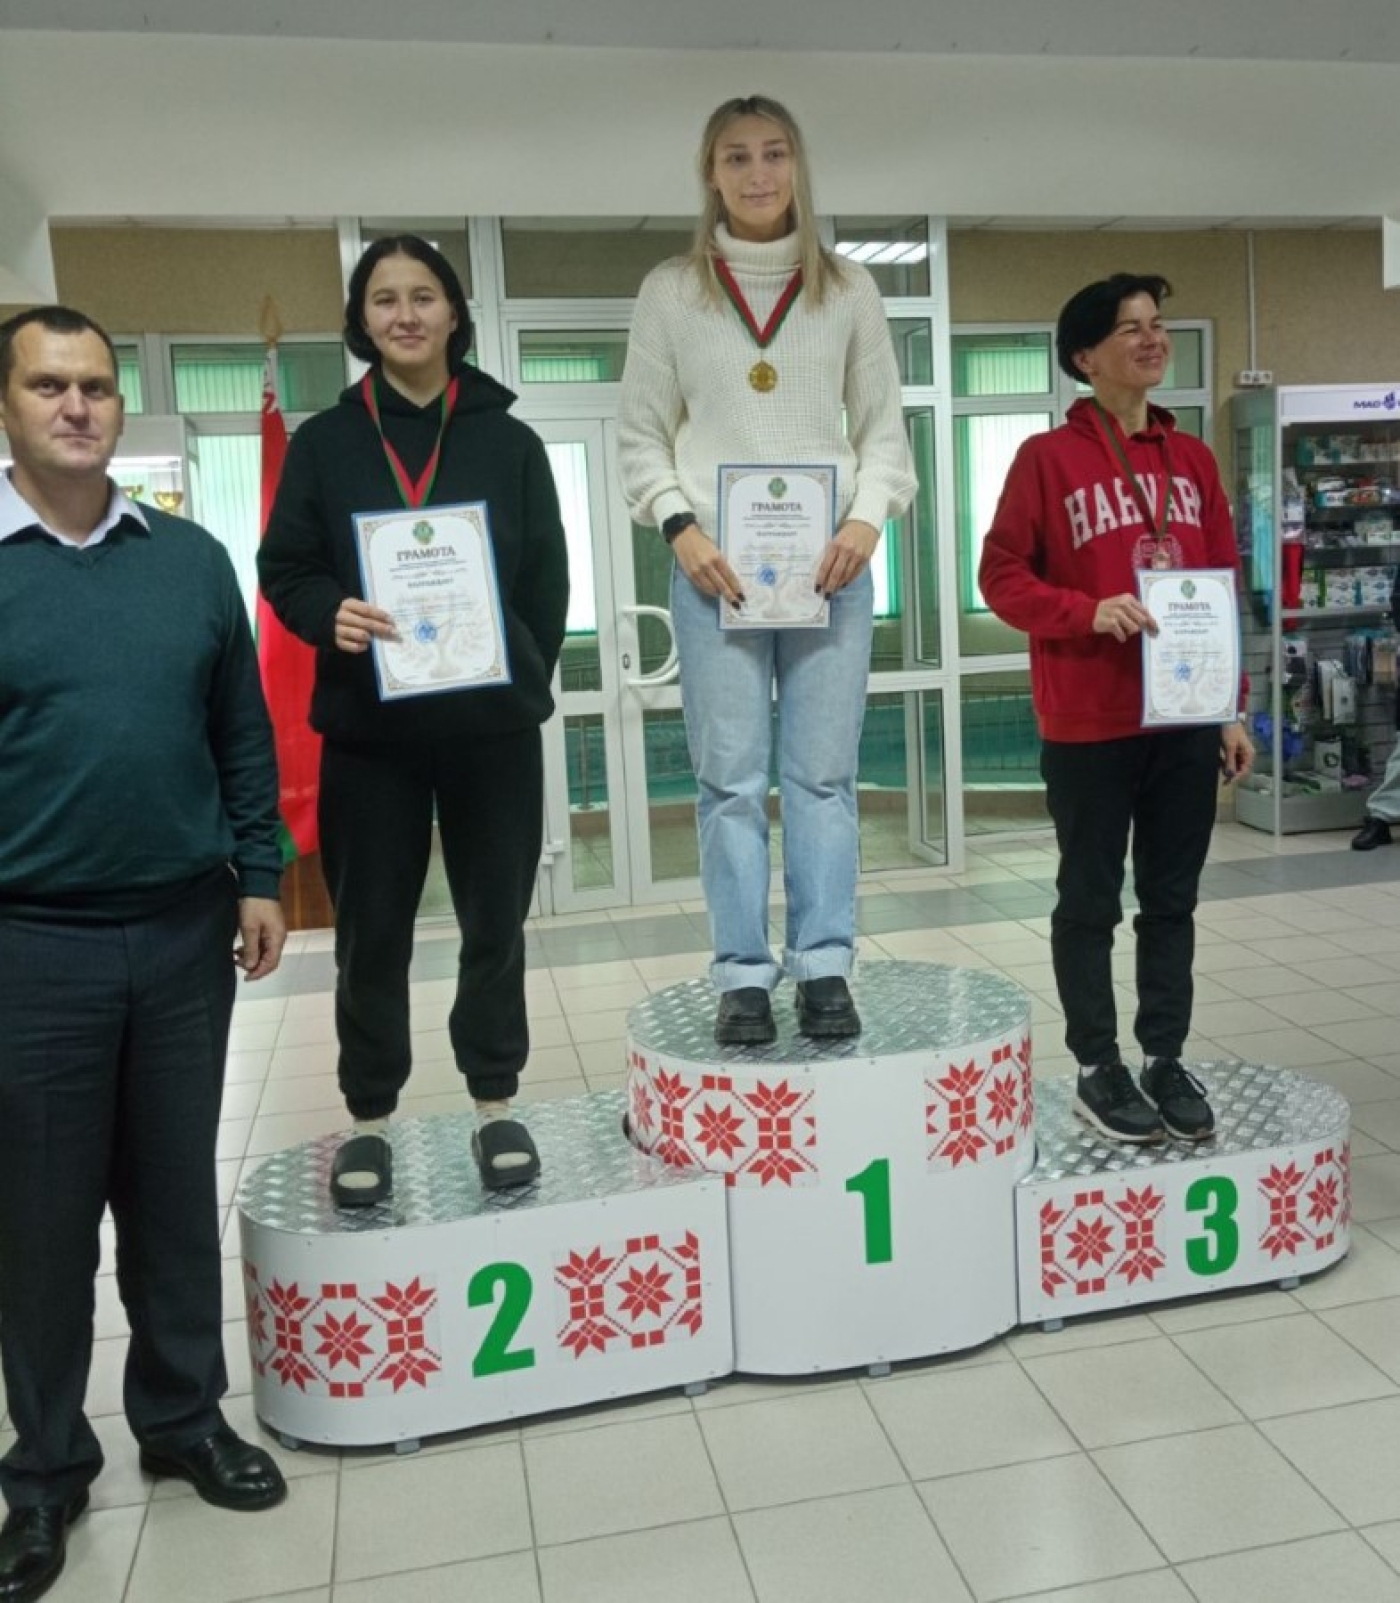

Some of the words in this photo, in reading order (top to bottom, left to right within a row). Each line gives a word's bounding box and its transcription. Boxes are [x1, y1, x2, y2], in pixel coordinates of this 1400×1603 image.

[751, 501, 803, 512] ГРАМОТА
[396, 545, 456, 561] ГРАМОТА
[1168, 601, 1211, 612] ГРАМОТА
[845, 1158, 894, 1265] 1
[1184, 1176, 1239, 1277] 3
[467, 1262, 536, 1378] 2
